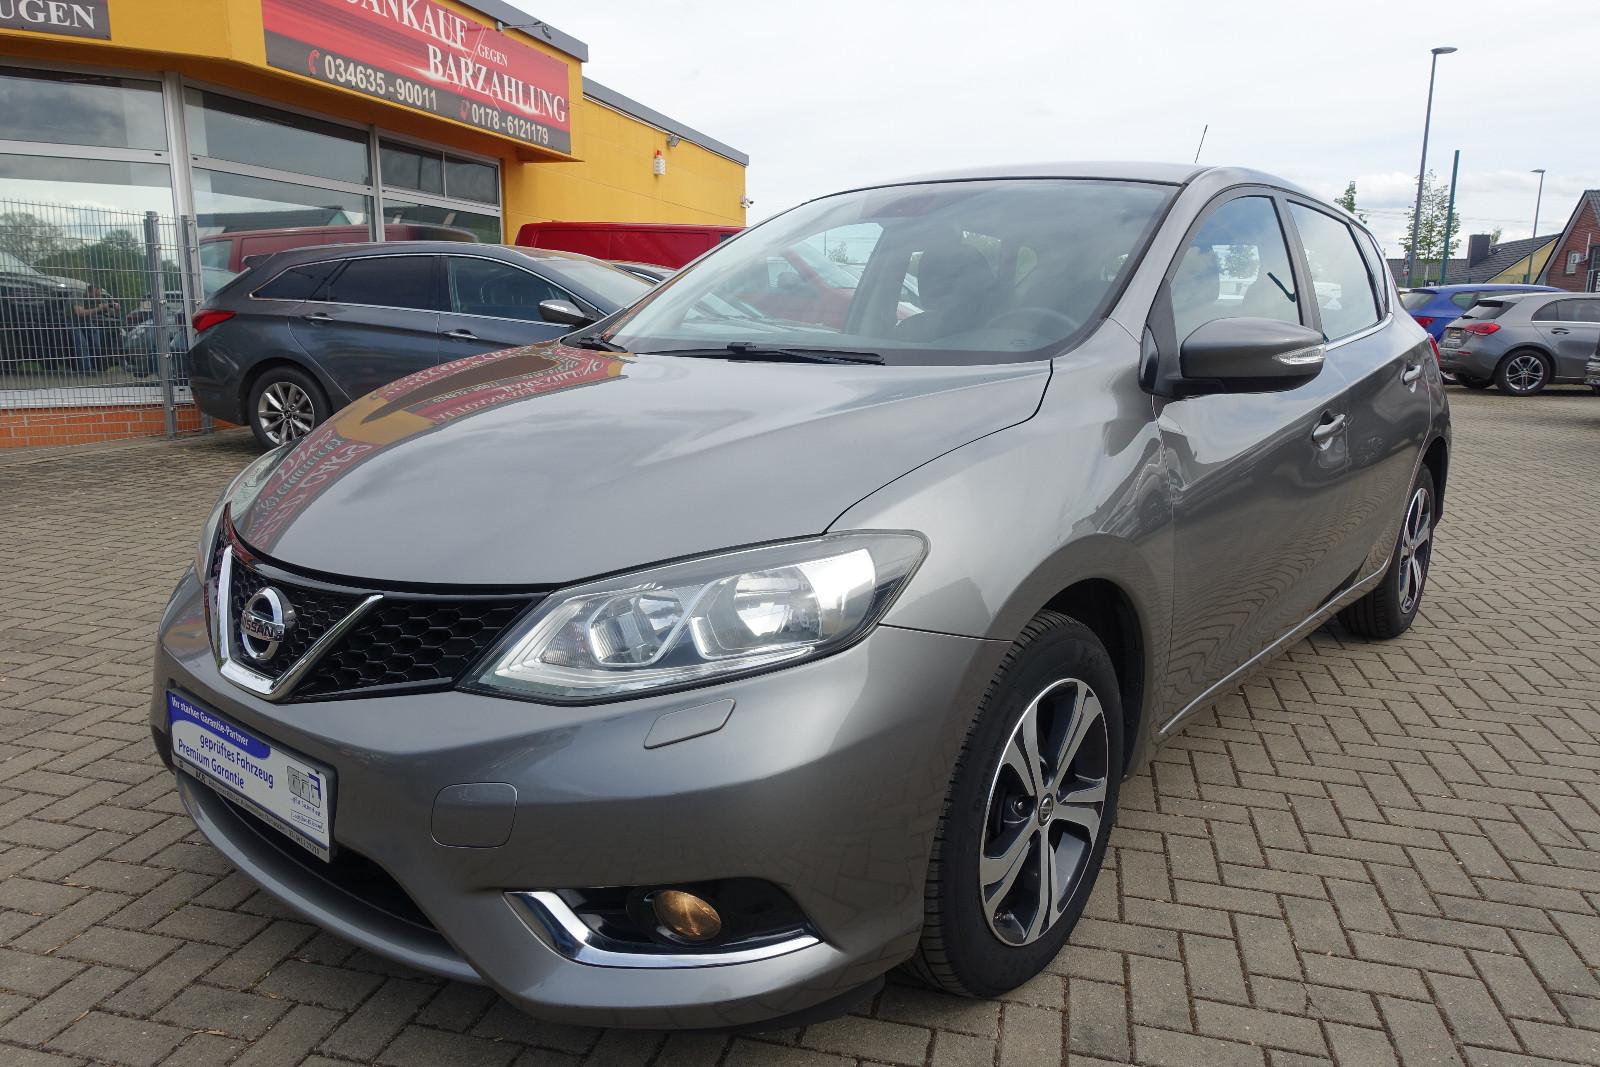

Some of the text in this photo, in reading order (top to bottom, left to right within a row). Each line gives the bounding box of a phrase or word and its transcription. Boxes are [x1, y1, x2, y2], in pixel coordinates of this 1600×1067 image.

[346, 0, 468, 50] NKAUF
[477, 43, 508, 67] GEGEN
[427, 43, 566, 122] BARZAHLUNG
[200, 712, 249, 746] Garantie-Partner
[178, 739, 210, 768] Premium
[211, 760, 245, 789] Garantie
[200, 735, 235, 763] geprüftes
[236, 752, 274, 789] Fahrzeug
